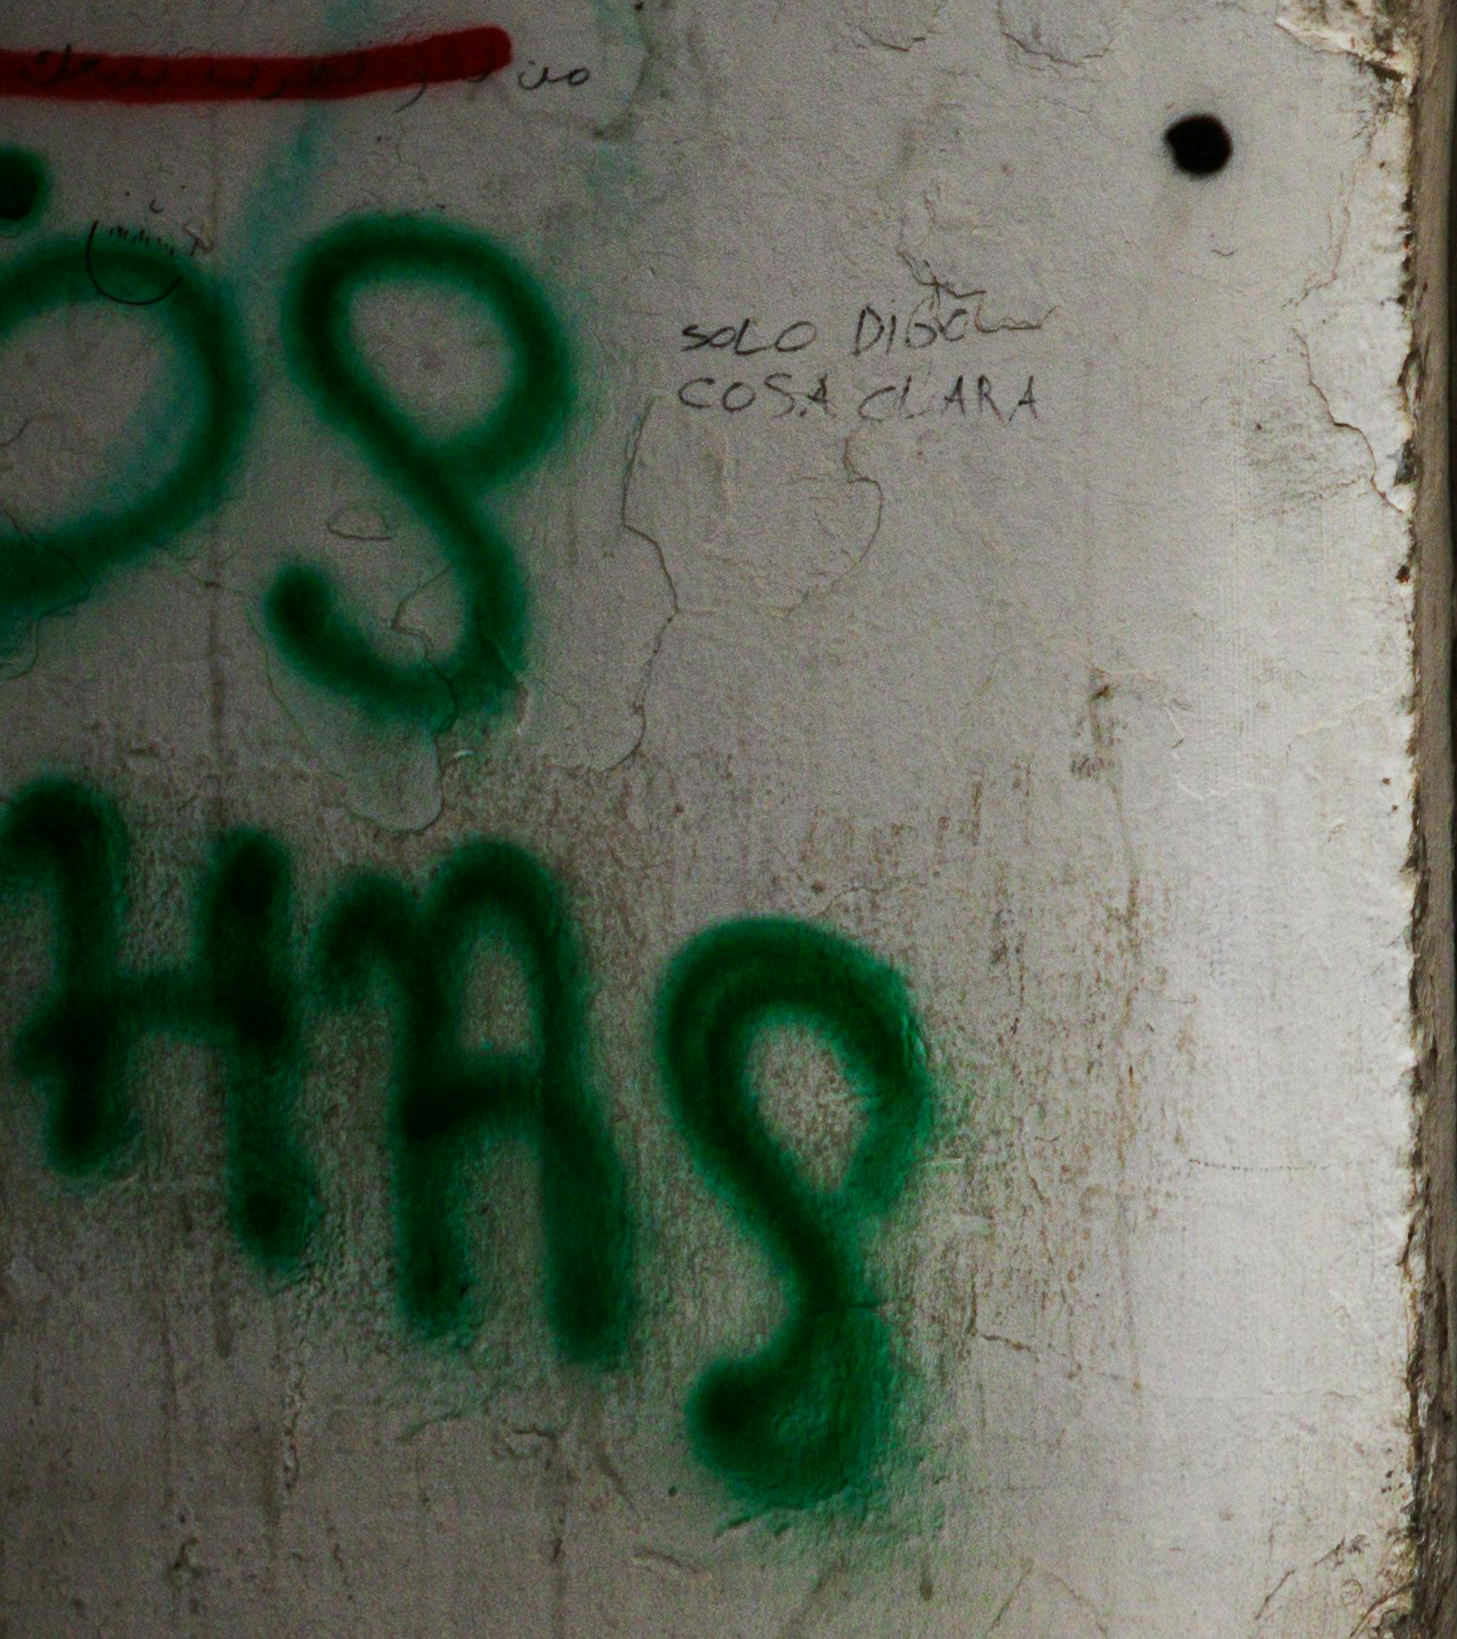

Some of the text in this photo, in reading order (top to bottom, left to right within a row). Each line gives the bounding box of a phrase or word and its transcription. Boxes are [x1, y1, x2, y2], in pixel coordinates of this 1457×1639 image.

[682, 317, 817, 356] SOLO
[678, 374, 1040, 422] COSA CLARA
